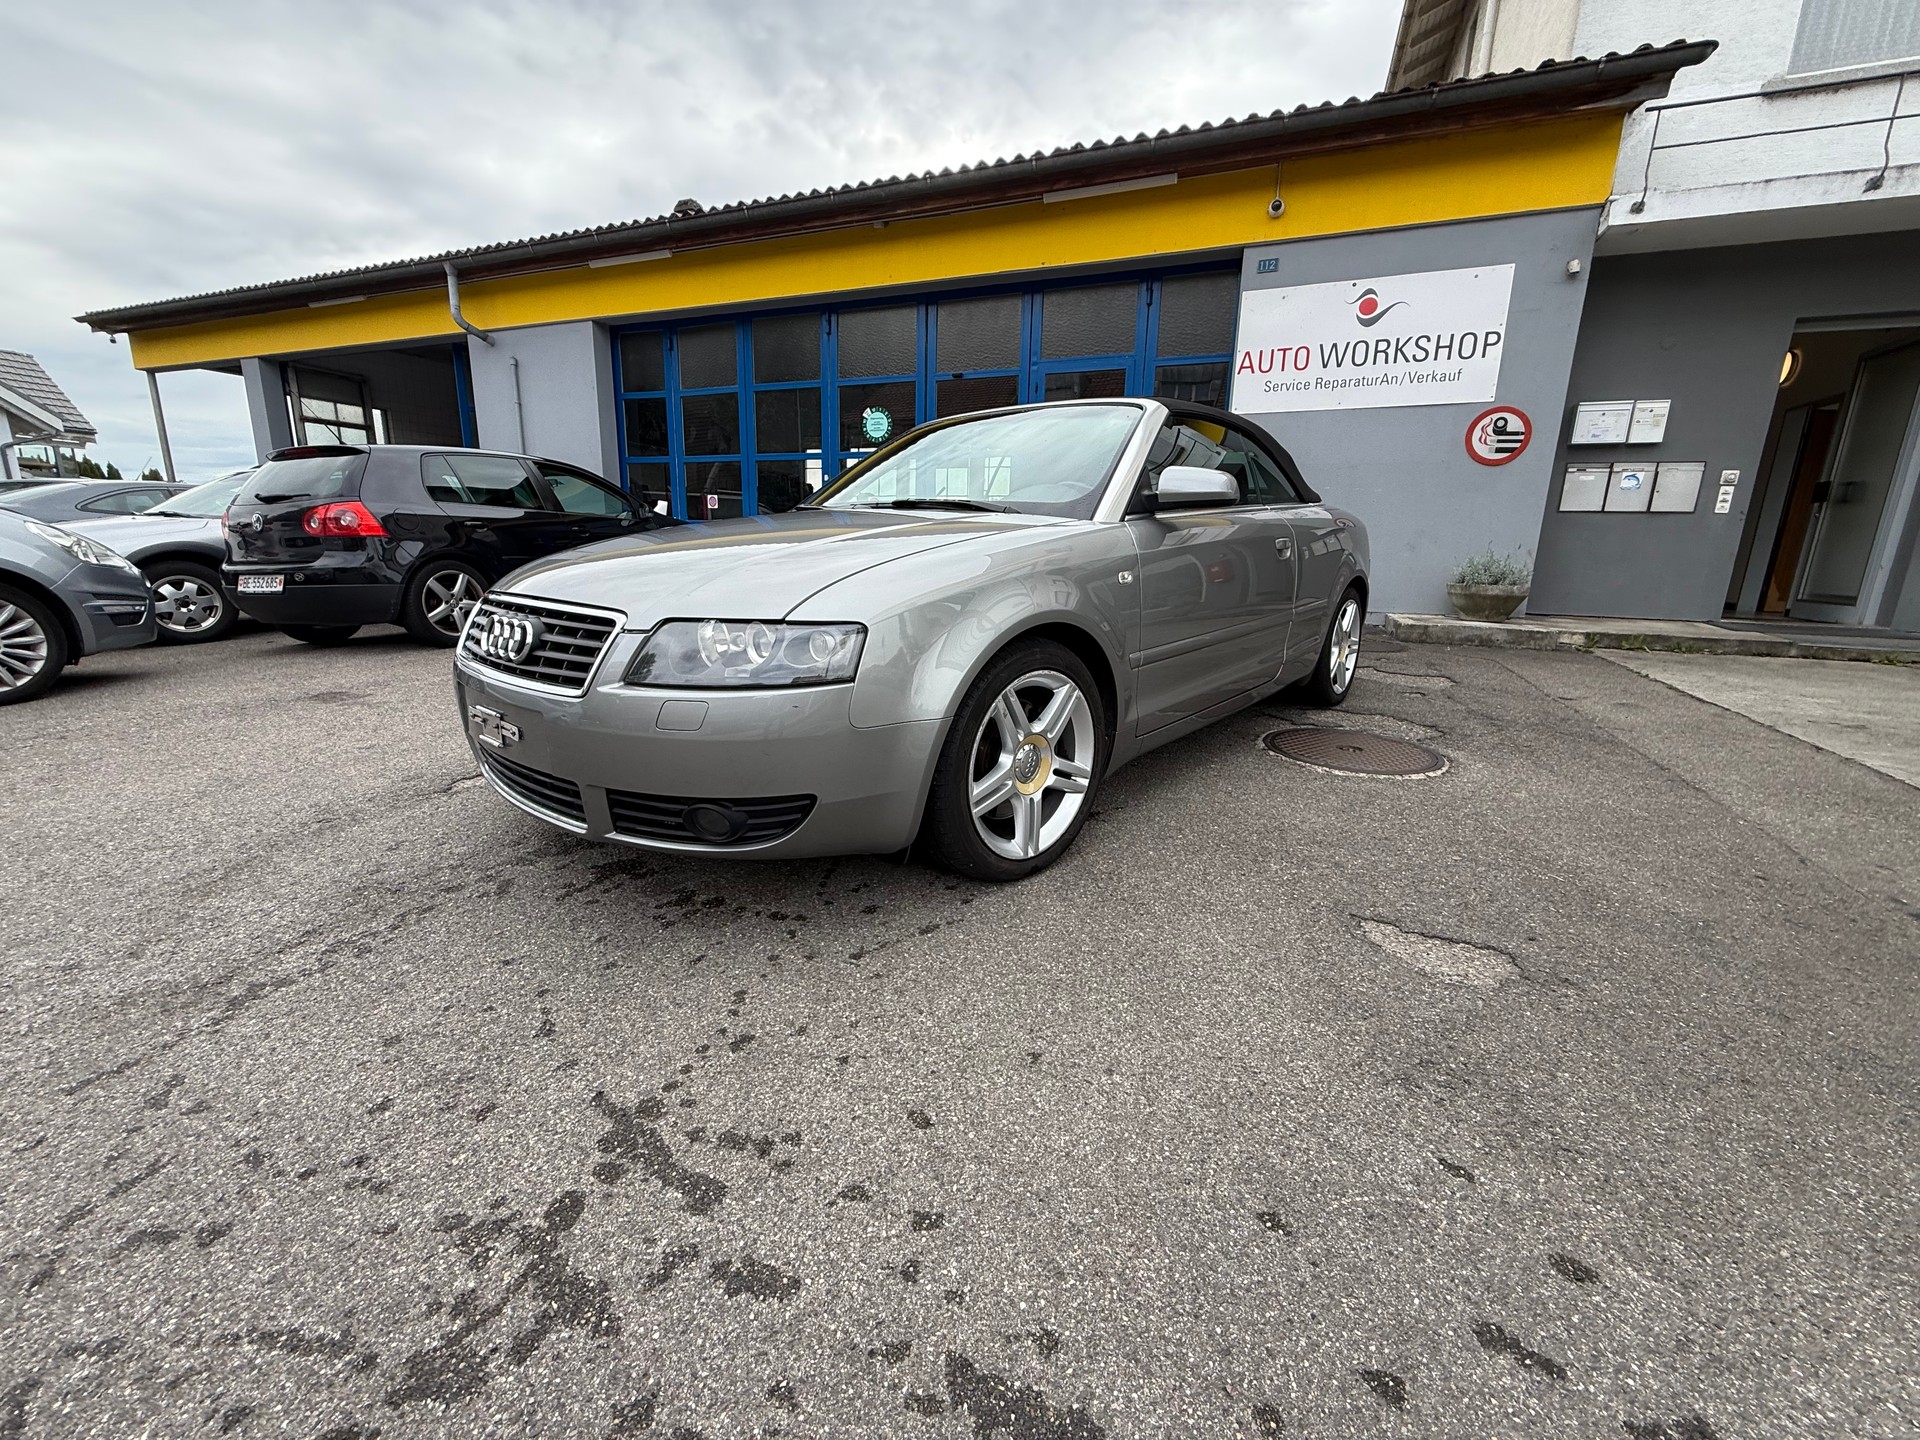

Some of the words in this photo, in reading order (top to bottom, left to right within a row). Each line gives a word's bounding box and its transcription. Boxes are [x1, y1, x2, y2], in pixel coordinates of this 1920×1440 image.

[1259, 260, 1276, 271] 112
[1237, 346, 1310, 375] AUTO
[1319, 331, 1502, 369] WORKSHOP
[1263, 379, 1311, 393] Service
[1314, 368, 1463, 392] ReparaturAn/Verkauf
